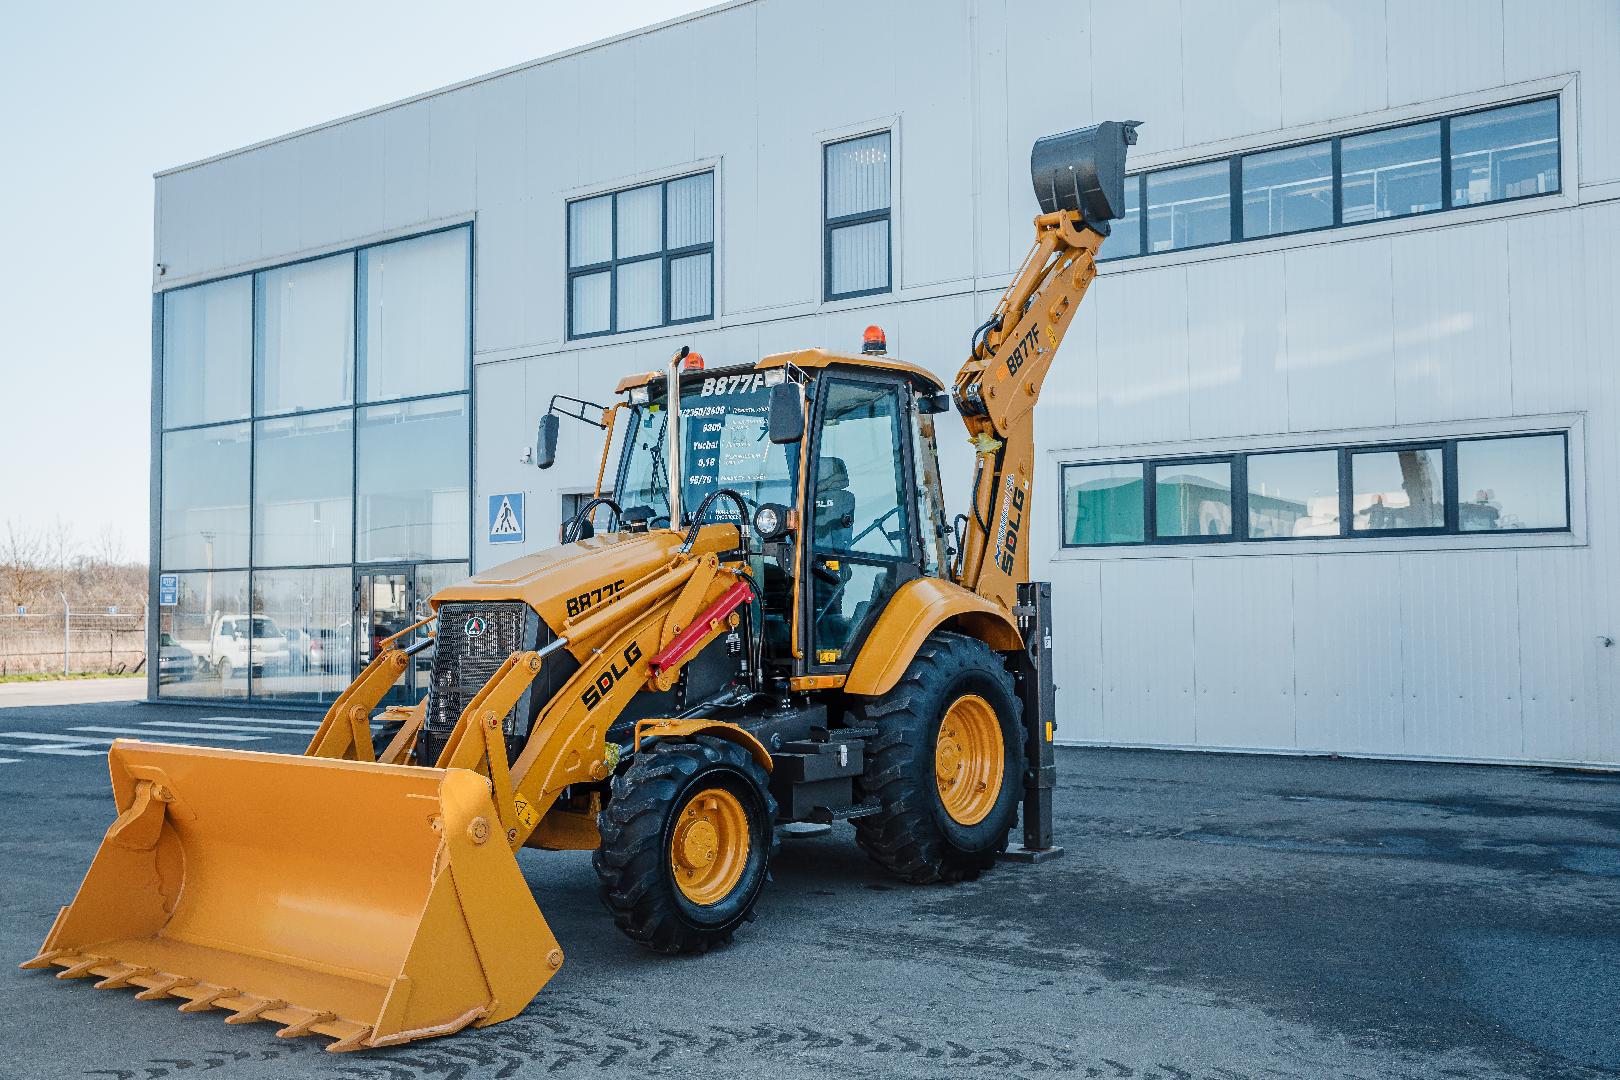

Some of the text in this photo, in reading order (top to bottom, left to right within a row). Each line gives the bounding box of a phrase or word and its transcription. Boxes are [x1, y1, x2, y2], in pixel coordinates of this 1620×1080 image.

[1006, 323, 1039, 377] B877F
[701, 374, 764, 397] B877F
[1001, 487, 1024, 576] SDLG
[581, 641, 642, 711] SDLG
